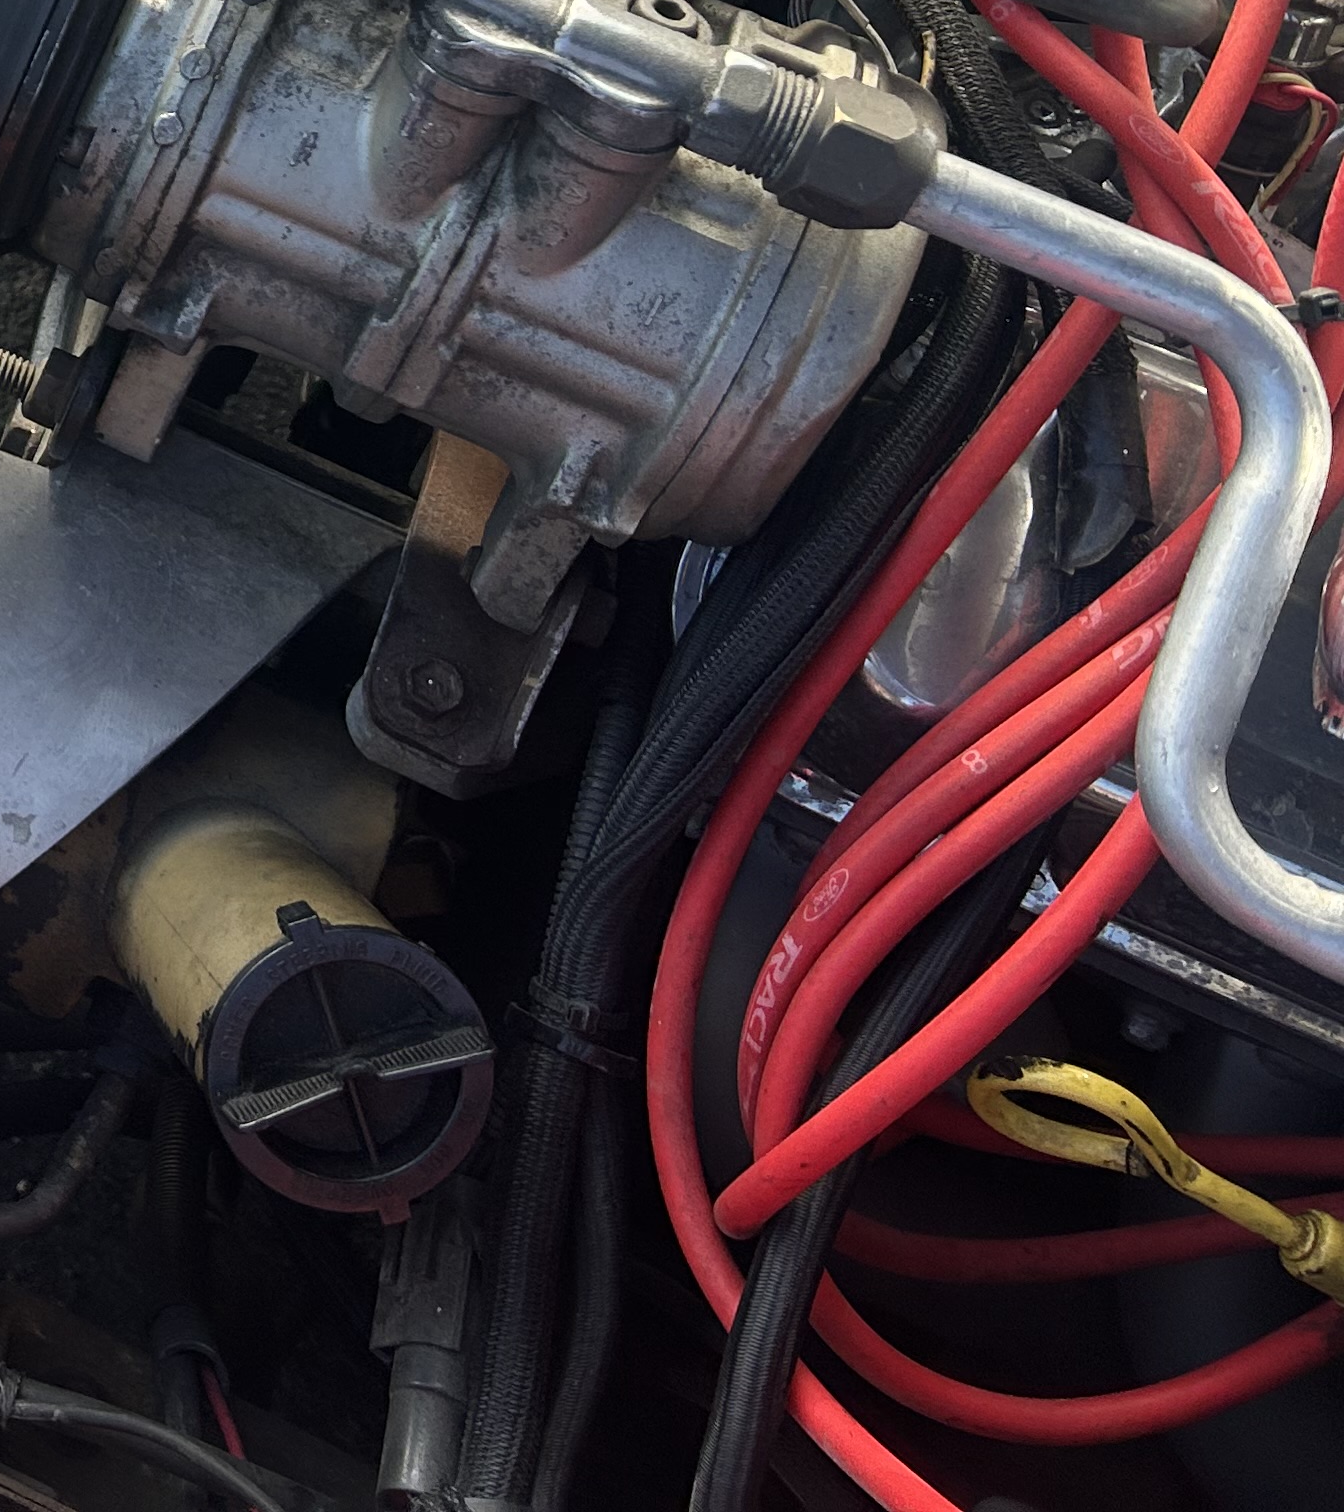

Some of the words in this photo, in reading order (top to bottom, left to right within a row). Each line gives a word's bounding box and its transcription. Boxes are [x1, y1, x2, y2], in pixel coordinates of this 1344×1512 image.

[1192, 179, 1296, 307] RACI
[961, 749, 988, 776] 8
[742, 934, 804, 1070] RACI
